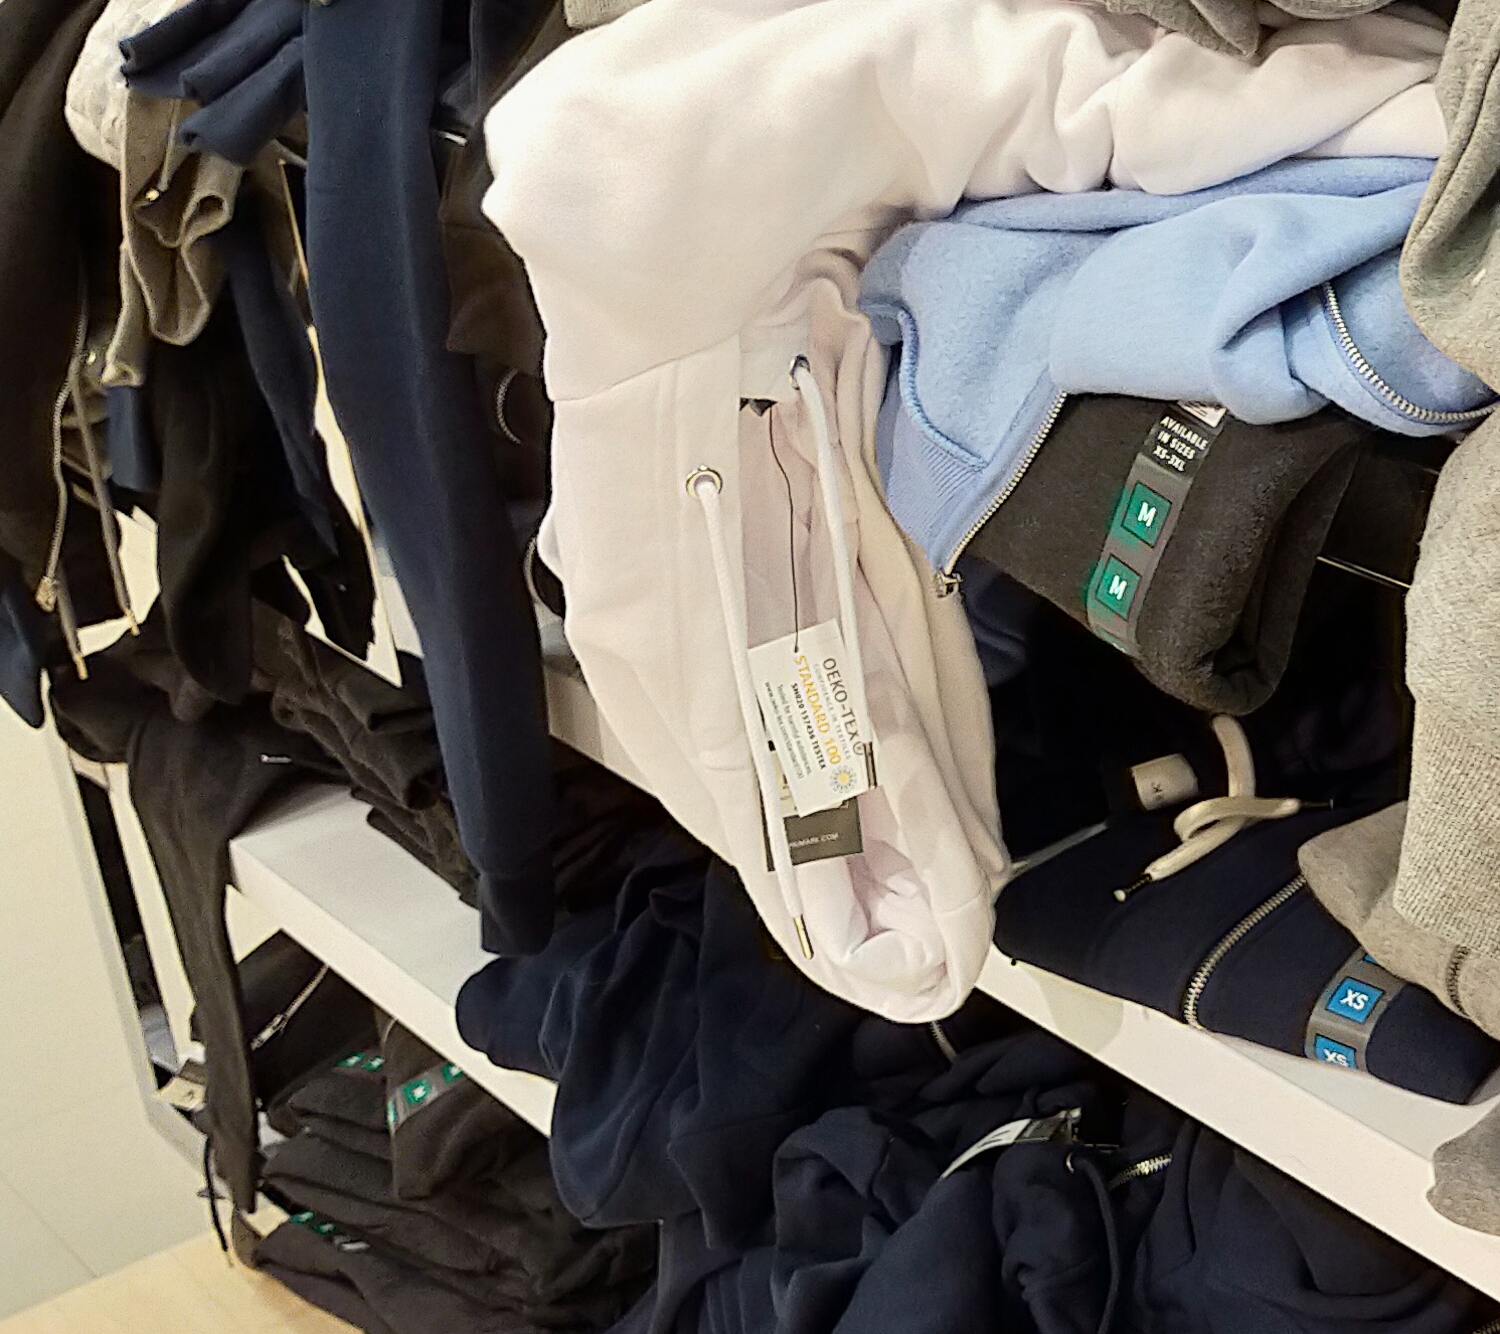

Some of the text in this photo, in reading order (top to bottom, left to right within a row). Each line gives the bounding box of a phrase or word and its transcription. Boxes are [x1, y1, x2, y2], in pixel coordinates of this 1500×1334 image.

[1157, 430, 1196, 460] IN SIZES
[1160, 415, 1209, 451] AVAILABLE
[1137, 501, 1157, 528] M
[1109, 574, 1128, 601] M
[794, 655, 842, 765] STANDARD 100
[1340, 987, 1369, 1011] XS
[1323, 1048, 1349, 1068] XS
